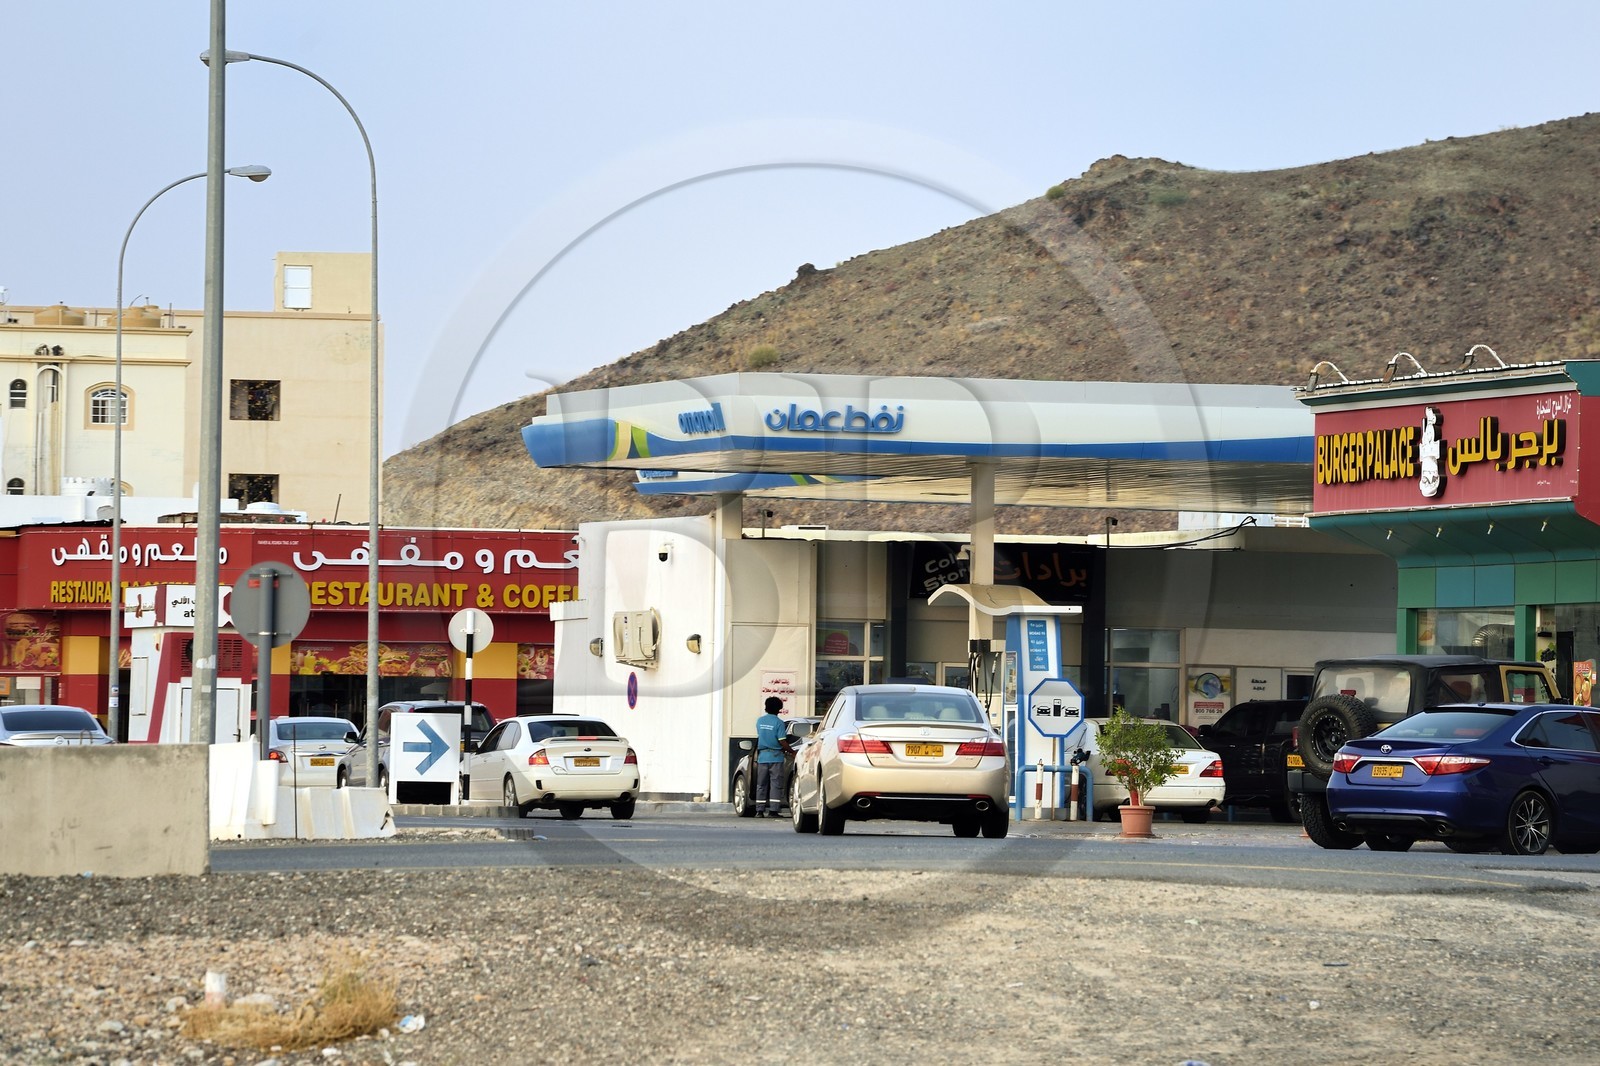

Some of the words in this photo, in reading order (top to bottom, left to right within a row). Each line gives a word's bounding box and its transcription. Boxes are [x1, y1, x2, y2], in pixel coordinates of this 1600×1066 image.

[1316, 432, 1365, 485] BURGER
[1366, 426, 1416, 481] PALACE
[1448, 416, 1502, 475] بالس
[1507, 419, 1559, 469] برجر
[144, 537, 228, 567] معم
[924, 553, 956, 574] Col
[51, 580, 129, 604] RESTAURAT
[923, 568, 967, 592] Stor
[306, 581, 469, 607] ESTAURANT
[476, 583, 495, 608] &
[183, 608, 195, 618] at
